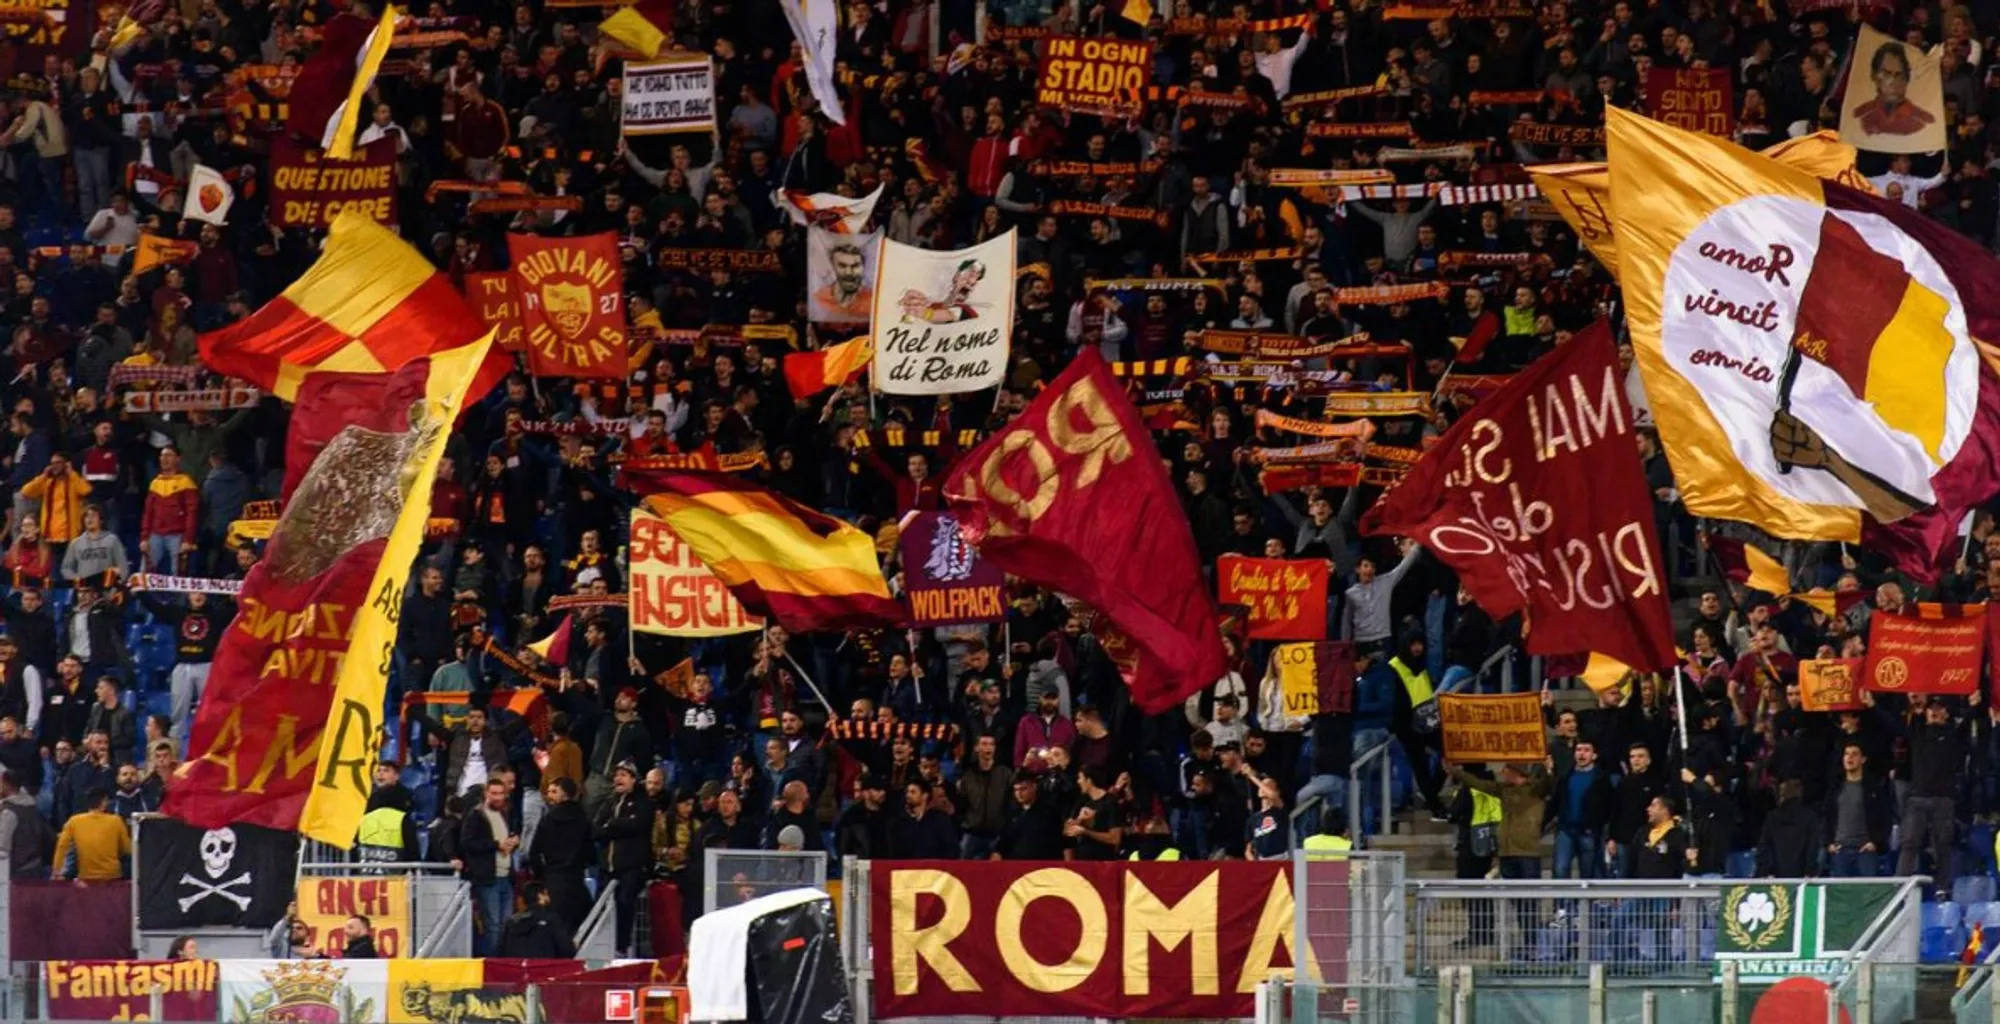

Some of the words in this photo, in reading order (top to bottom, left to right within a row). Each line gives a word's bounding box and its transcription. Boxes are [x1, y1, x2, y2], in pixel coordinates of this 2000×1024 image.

[1048, 39, 1076, 57] IN
[1082, 41, 1148, 64] OGNI
[1045, 60, 1143, 94] STADIO
[274, 165, 392, 191] QUESTIONE
[518, 248, 616, 288] GIOVANI
[1699, 242, 1794, 287] amoR
[482, 278, 507, 295] TU
[600, 292, 620, 315] 27
[484, 302, 509, 320] LA
[1685, 289, 1779, 332] vincit
[529, 323, 625, 368] ULTRAS
[886, 327, 930, 354] Nel
[934, 327, 1000, 354] nome
[889, 356, 919, 381] di
[920, 356, 992, 383] Roma
[911, 585, 1003, 621] WOLFPACK
[317, 879, 390, 917] ANTI
[890, 867, 1325, 996] ROMA
